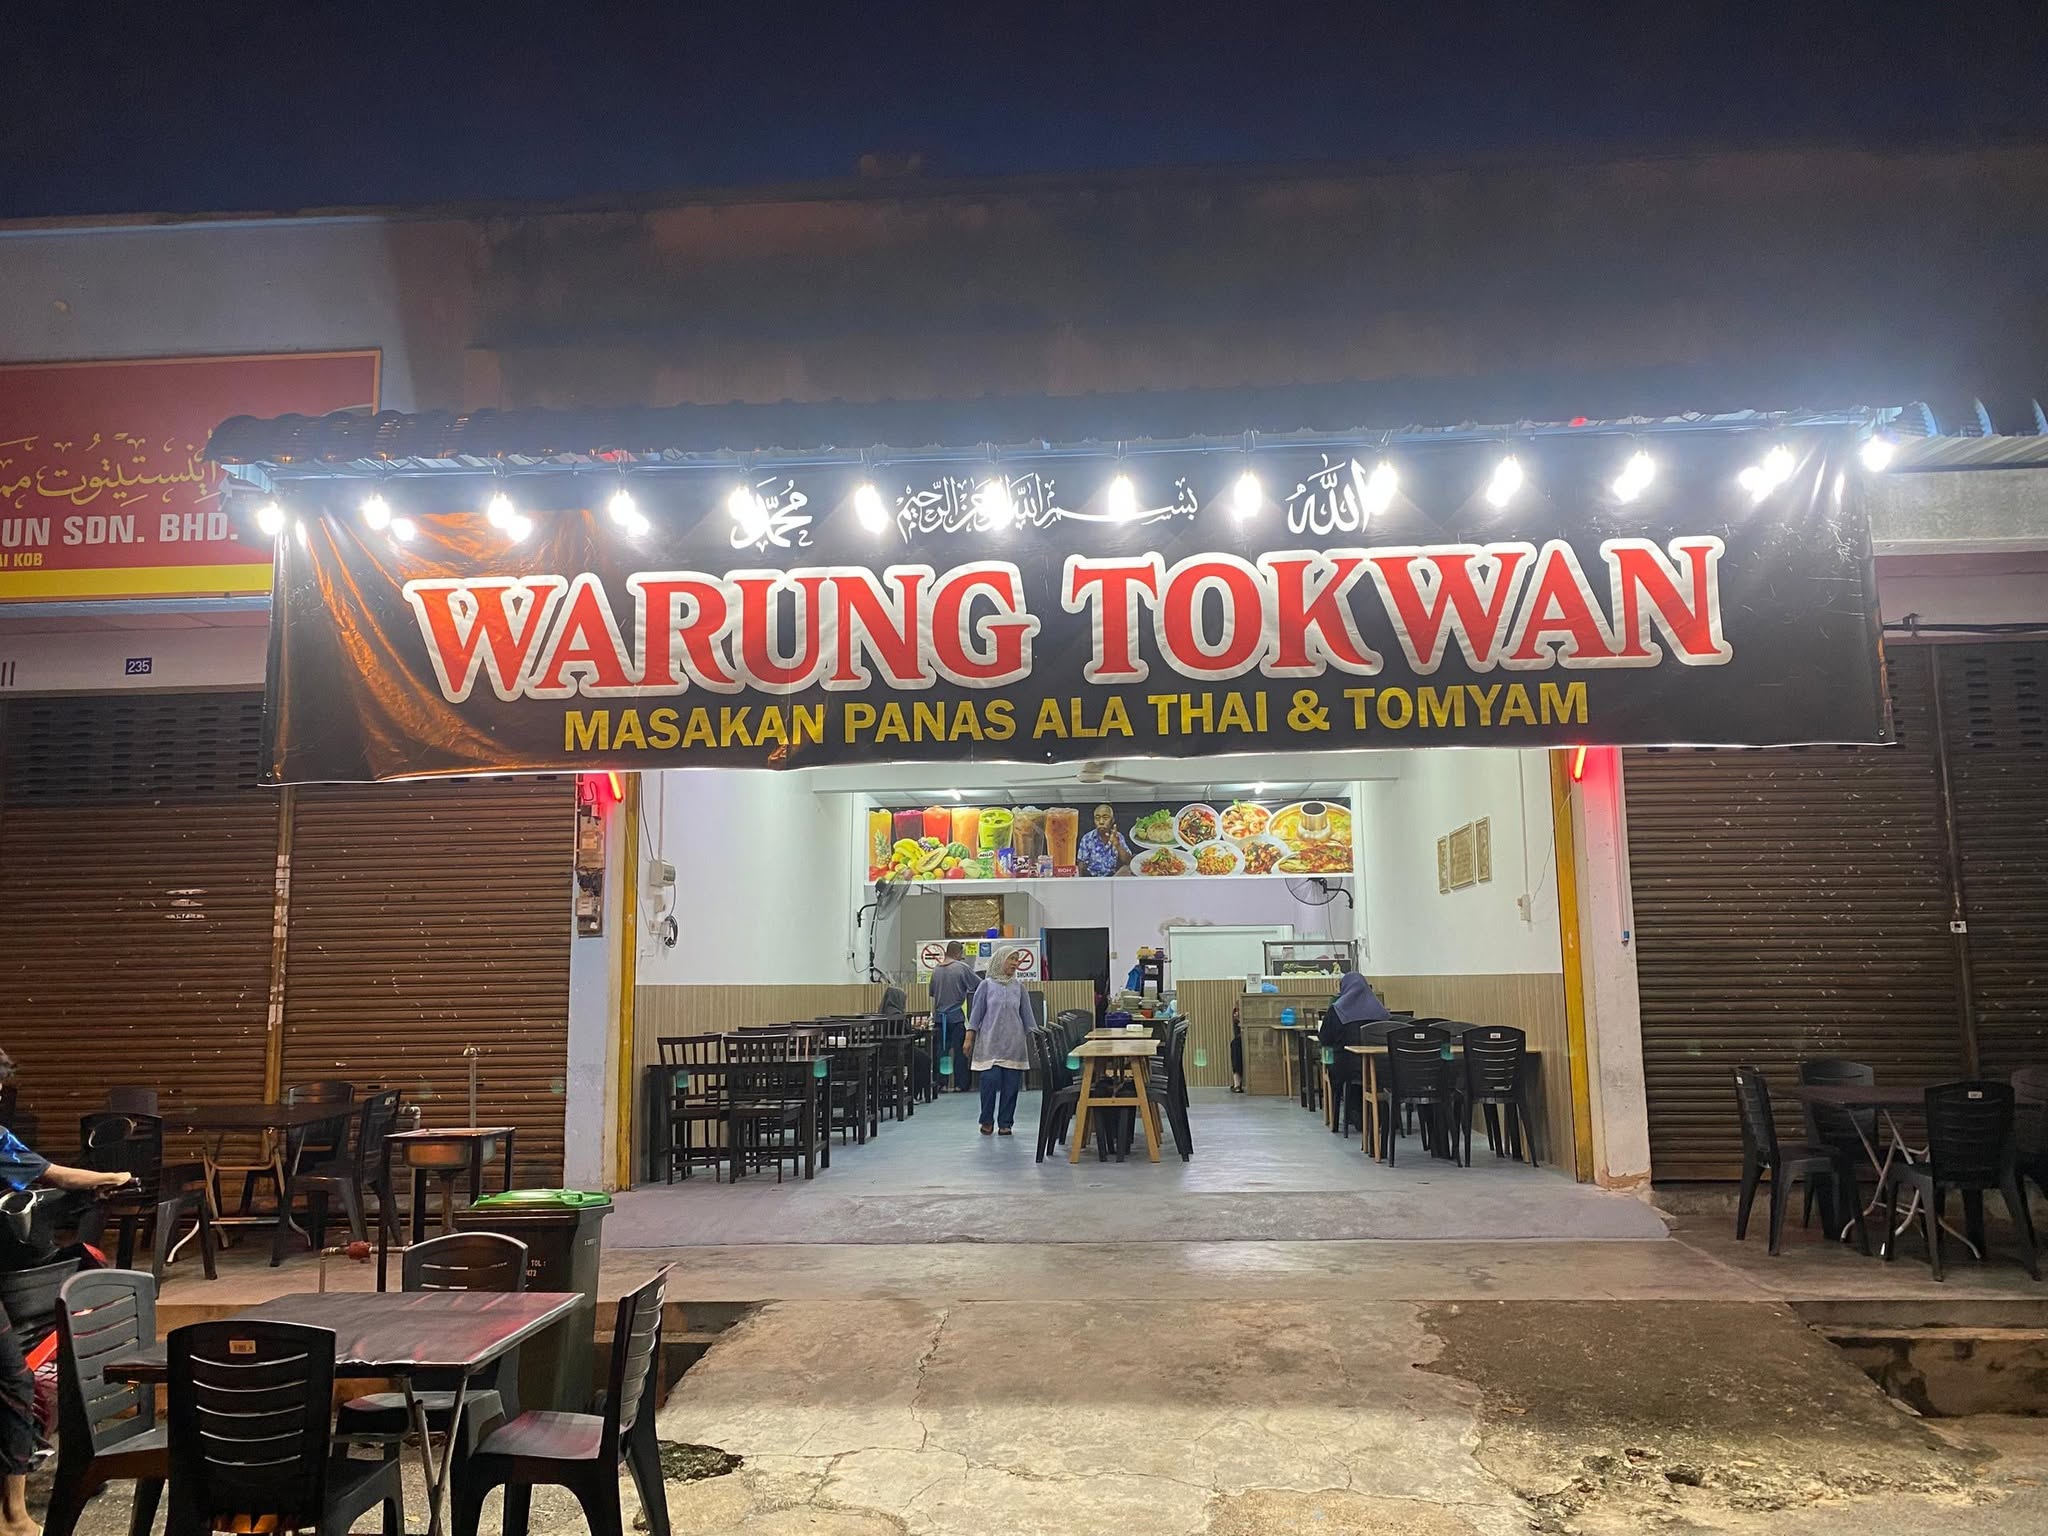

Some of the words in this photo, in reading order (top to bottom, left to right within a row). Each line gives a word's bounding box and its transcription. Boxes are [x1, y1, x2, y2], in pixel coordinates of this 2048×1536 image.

[63, 514, 145, 545] SDN.
[159, 512, 239, 541] BHD.
[13, 553, 43, 567] KOB
[402, 560, 1041, 702] WARUNG
[1062, 538, 1734, 684] TOKWAN
[127, 660, 150, 674] 235
[564, 704, 824, 751] MASAKAN
[844, 700, 1017, 743] PANAS
[1033, 697, 1133, 739] ALA
[1147, 691, 1268, 736] THAI
[1286, 689, 1331, 731] &
[1343, 682, 1588, 730] TOMYAM
